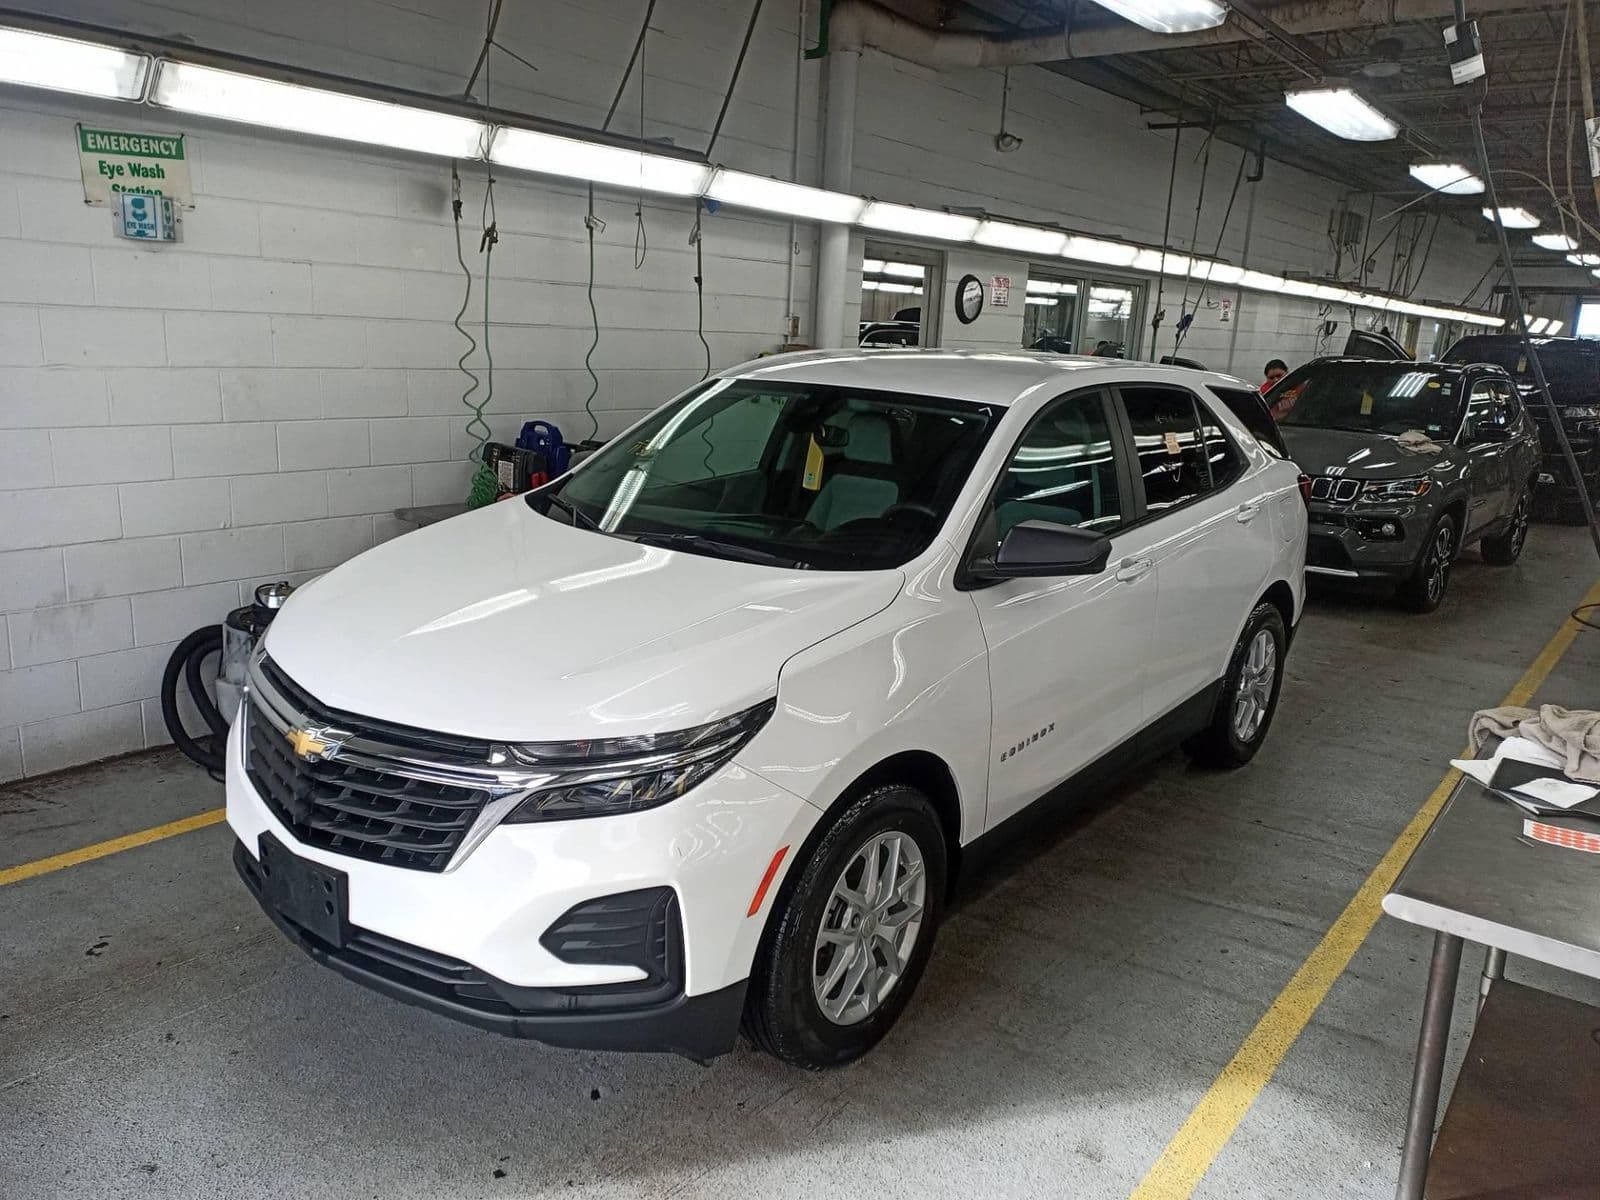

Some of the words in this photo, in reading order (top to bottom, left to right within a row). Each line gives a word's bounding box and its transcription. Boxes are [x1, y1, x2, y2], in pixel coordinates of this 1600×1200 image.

[86, 133, 177, 156] EMERGENCY
[98, 160, 125, 179] Eye
[127, 162, 165, 179] Wash
[1000, 722, 1055, 762] EQUINOX
